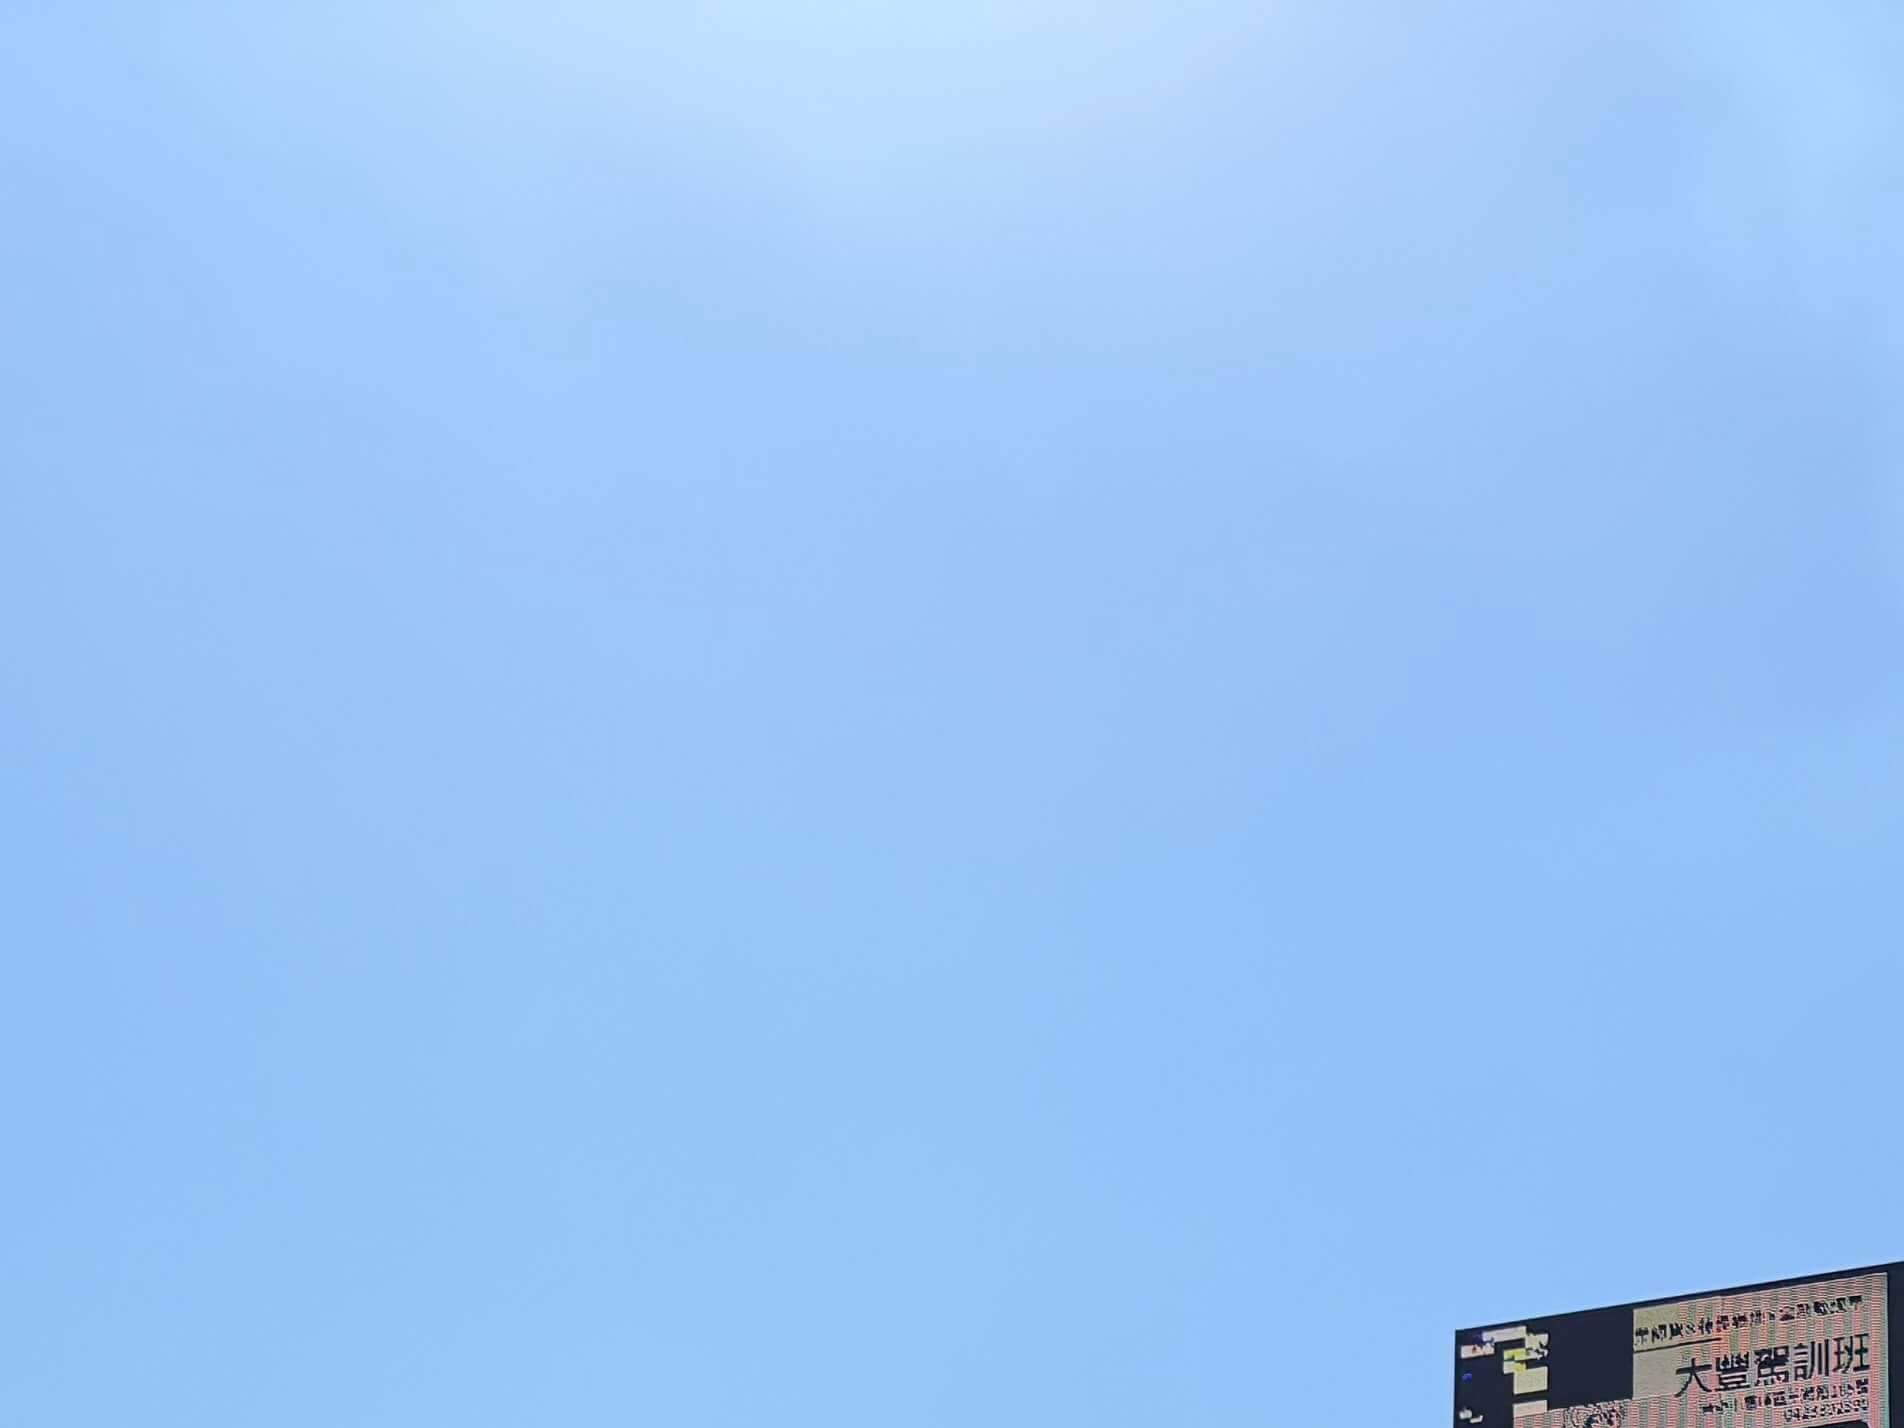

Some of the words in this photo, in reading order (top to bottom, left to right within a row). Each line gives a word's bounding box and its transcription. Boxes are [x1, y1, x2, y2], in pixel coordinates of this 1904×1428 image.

[1674, 1332, 1871, 1399] 大豐駕訓班
